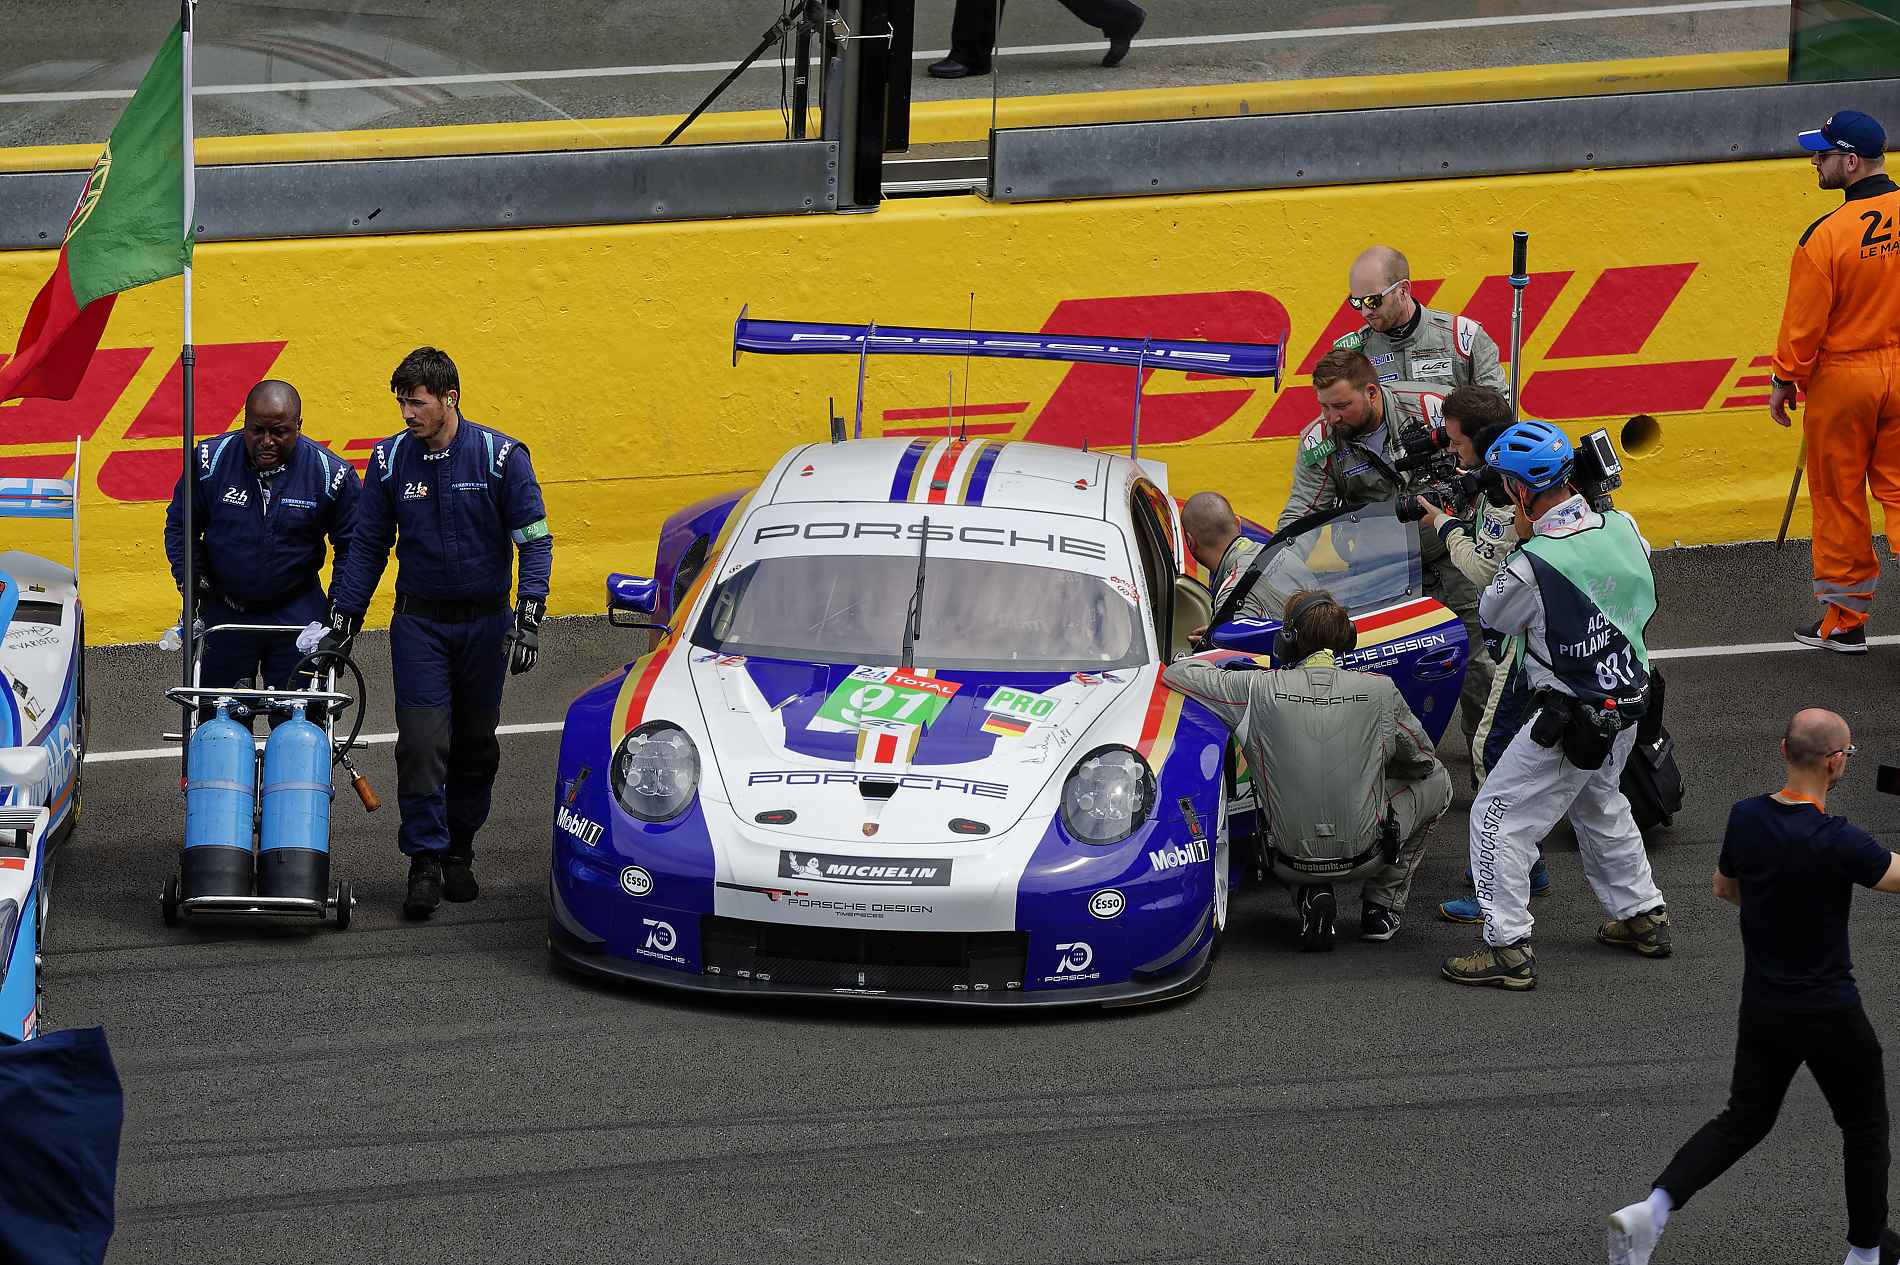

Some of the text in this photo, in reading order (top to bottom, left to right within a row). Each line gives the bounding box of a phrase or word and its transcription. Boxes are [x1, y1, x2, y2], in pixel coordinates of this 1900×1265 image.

[1860, 210, 1900, 247] 24
[1860, 246, 1878, 260] LE
[1880, 240, 1900, 255] MA
[1025, 262, 1736, 450] DHL
[1313, 439, 1336, 460] PITLA
[753, 521, 1106, 561] PORSCHE
[1474, 540, 1495, 560] 23
[1335, 633, 1446, 667] SCHE DESIGN
[1559, 628, 1612, 658] PITLANE
[893, 675, 954, 695] TOTAL
[840, 684, 933, 725] 91
[990, 689, 1055, 717] PRO
[1274, 693, 1369, 706] PORSCHE
[748, 772, 1009, 800] PORSCHE
[556, 805, 586, 839] Mobil
[1148, 842, 1197, 872] Mobil
[1477, 796, 1508, 903] BROADCASTER
[625, 871, 649, 889] Esso
[825, 862, 939, 880] MICHELIN
[787, 898, 934, 914] PORSCHE DESIGN
[1094, 898, 1121, 910] Esso
[642, 918, 677, 952] 70
[635, 947, 687, 964] PORSCHE
[1055, 941, 1093, 973] 70
[1043, 971, 1101, 983] PORSCHE
